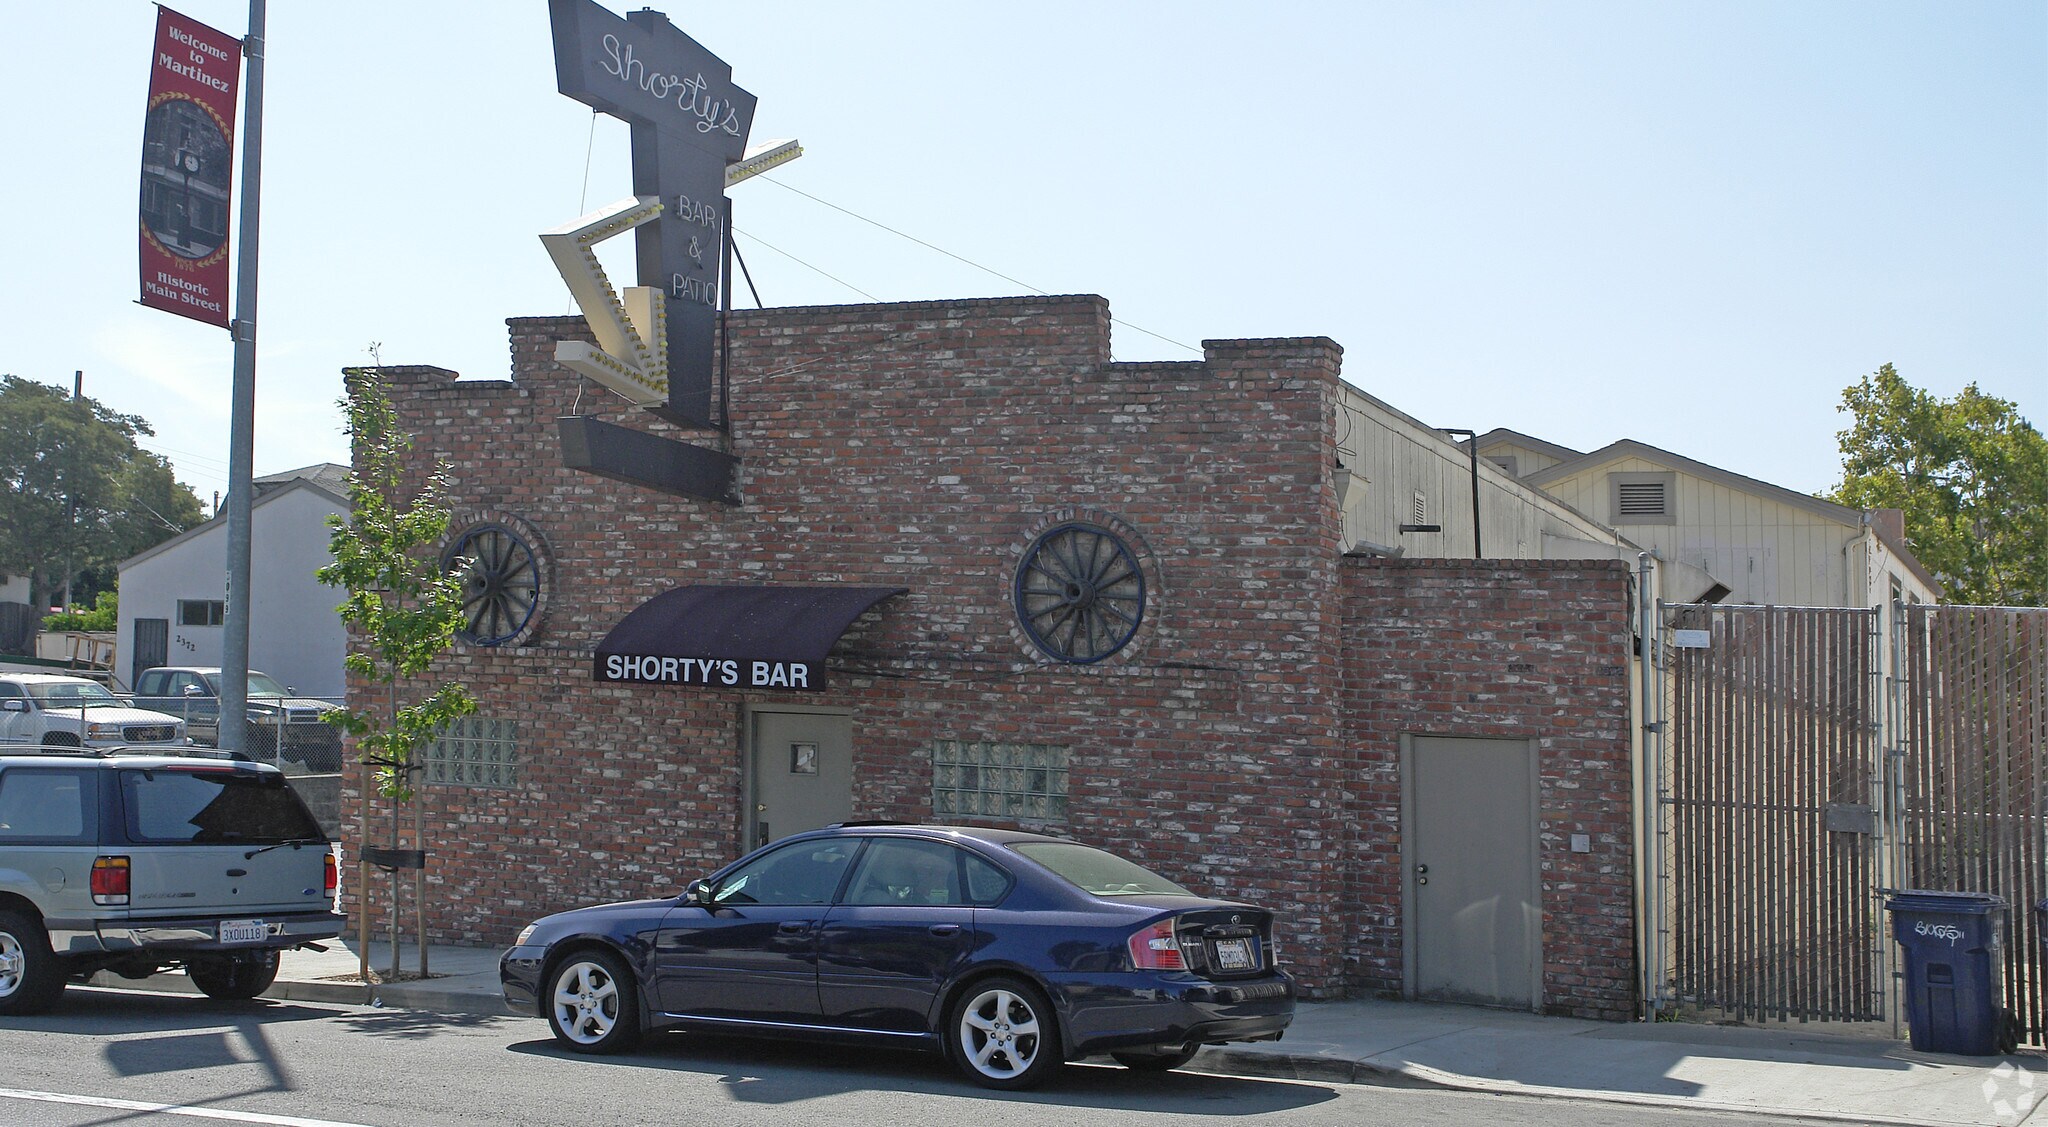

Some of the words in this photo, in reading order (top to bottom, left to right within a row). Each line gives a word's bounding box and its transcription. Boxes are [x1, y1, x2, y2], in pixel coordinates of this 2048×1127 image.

[168, 25, 228, 62] Welcome
[189, 50, 205, 65] to
[158, 52, 230, 94] Martinez
[600, 34, 741, 137] Shorty's
[677, 194, 716, 230] BAR
[688, 235, 702, 262] &
[145, 281, 178, 300] Main
[181, 291, 222, 313] Street
[157, 271, 210, 296] Historic
[672, 272, 717, 306] PATIO
[176, 634, 196, 652] 2372
[605, 654, 739, 686] SHORTY'S
[751, 660, 809, 689] BAR
